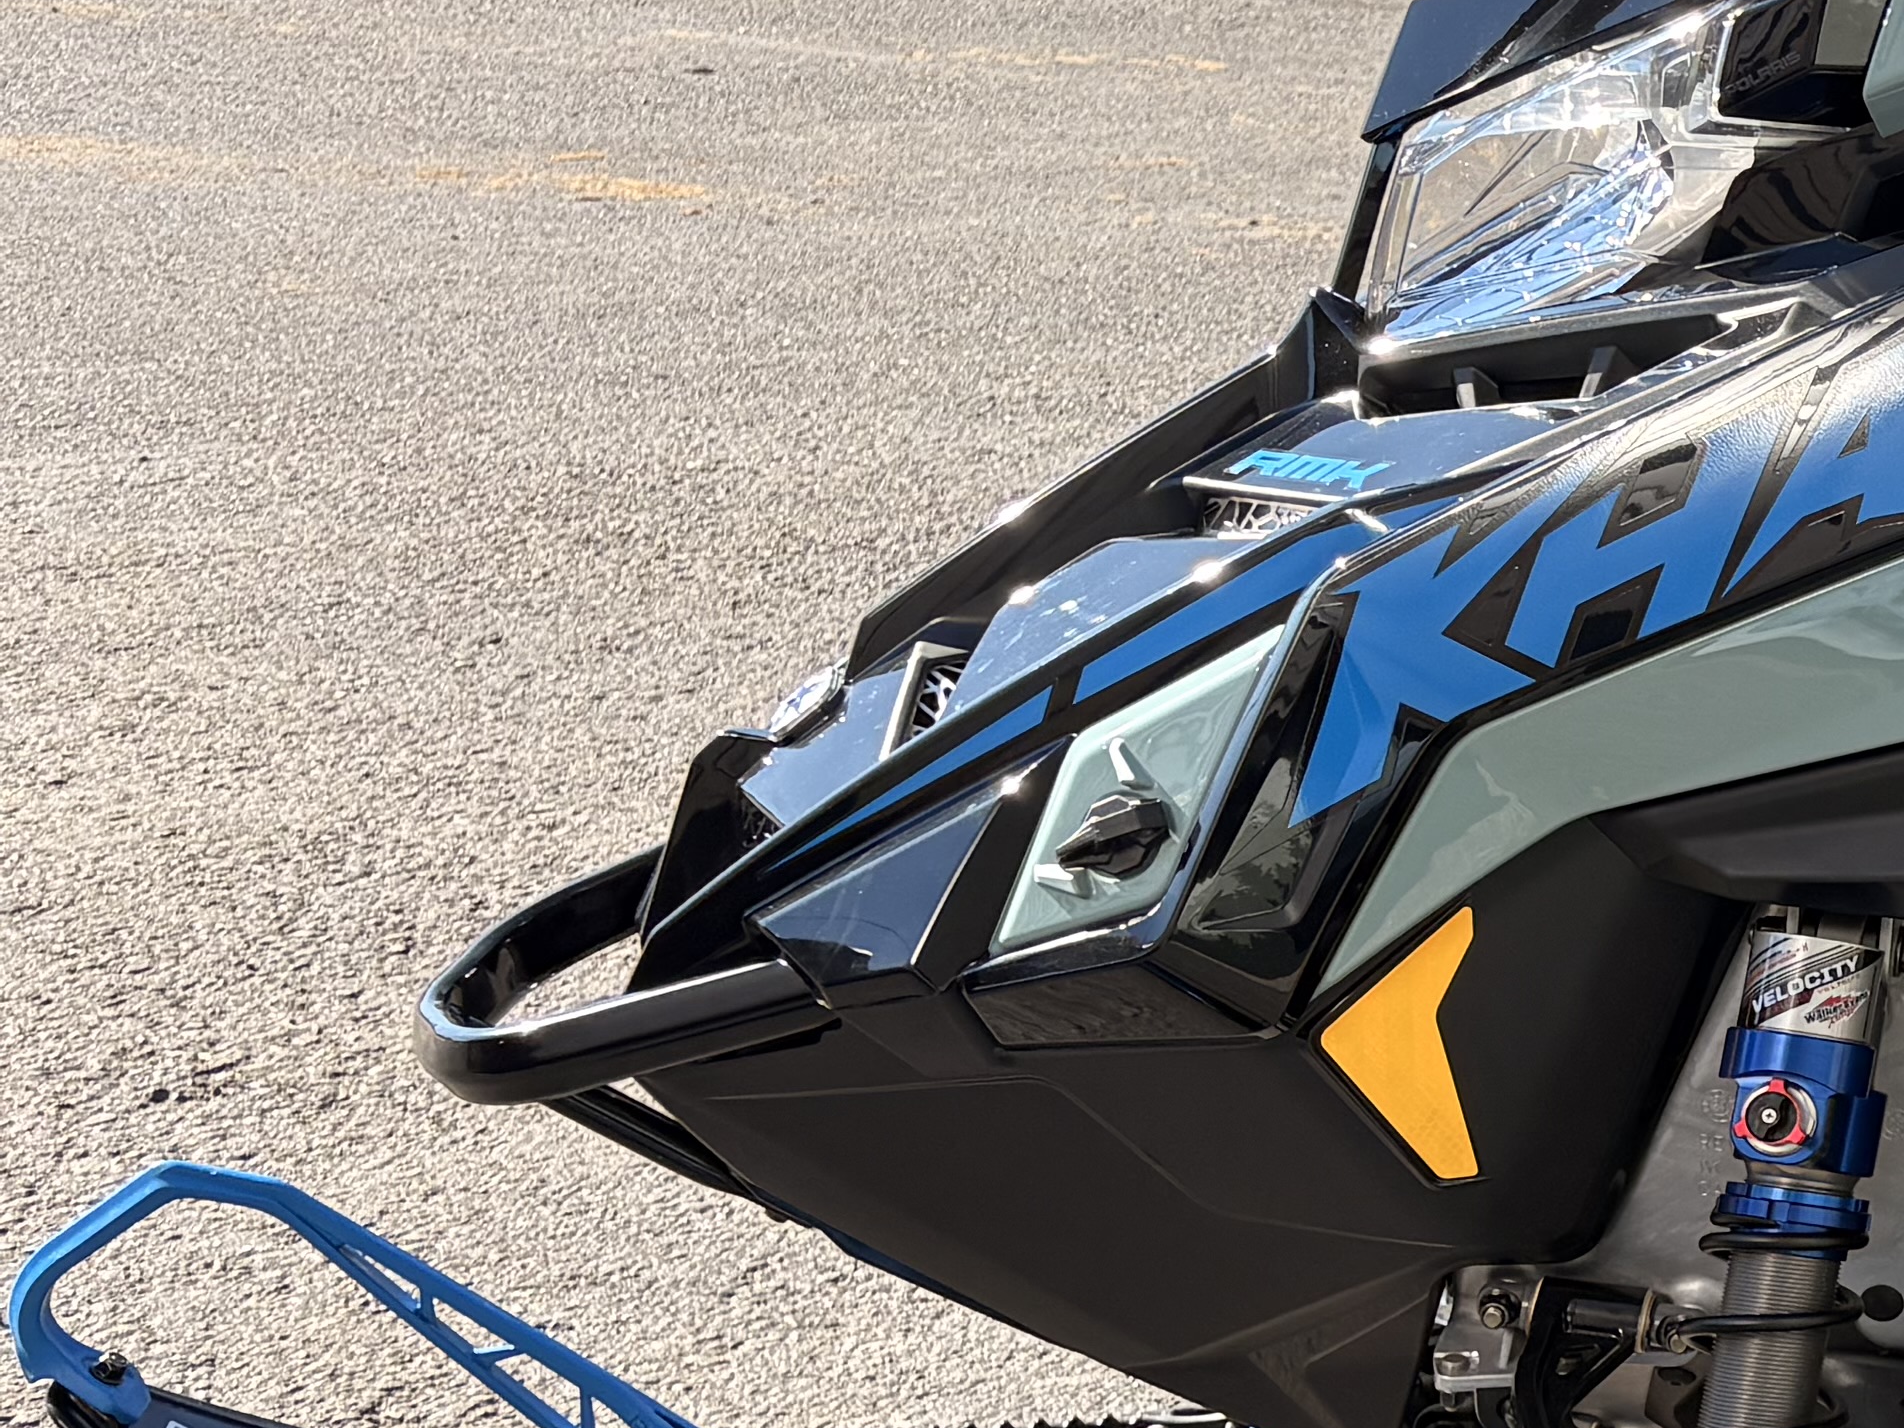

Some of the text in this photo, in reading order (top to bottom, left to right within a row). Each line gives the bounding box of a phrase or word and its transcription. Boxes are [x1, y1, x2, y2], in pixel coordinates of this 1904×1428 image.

[1724, 50, 1801, 94] POLARIS
[1224, 448, 1396, 491] RMK
[1752, 954, 1859, 1022] VELOCITY
